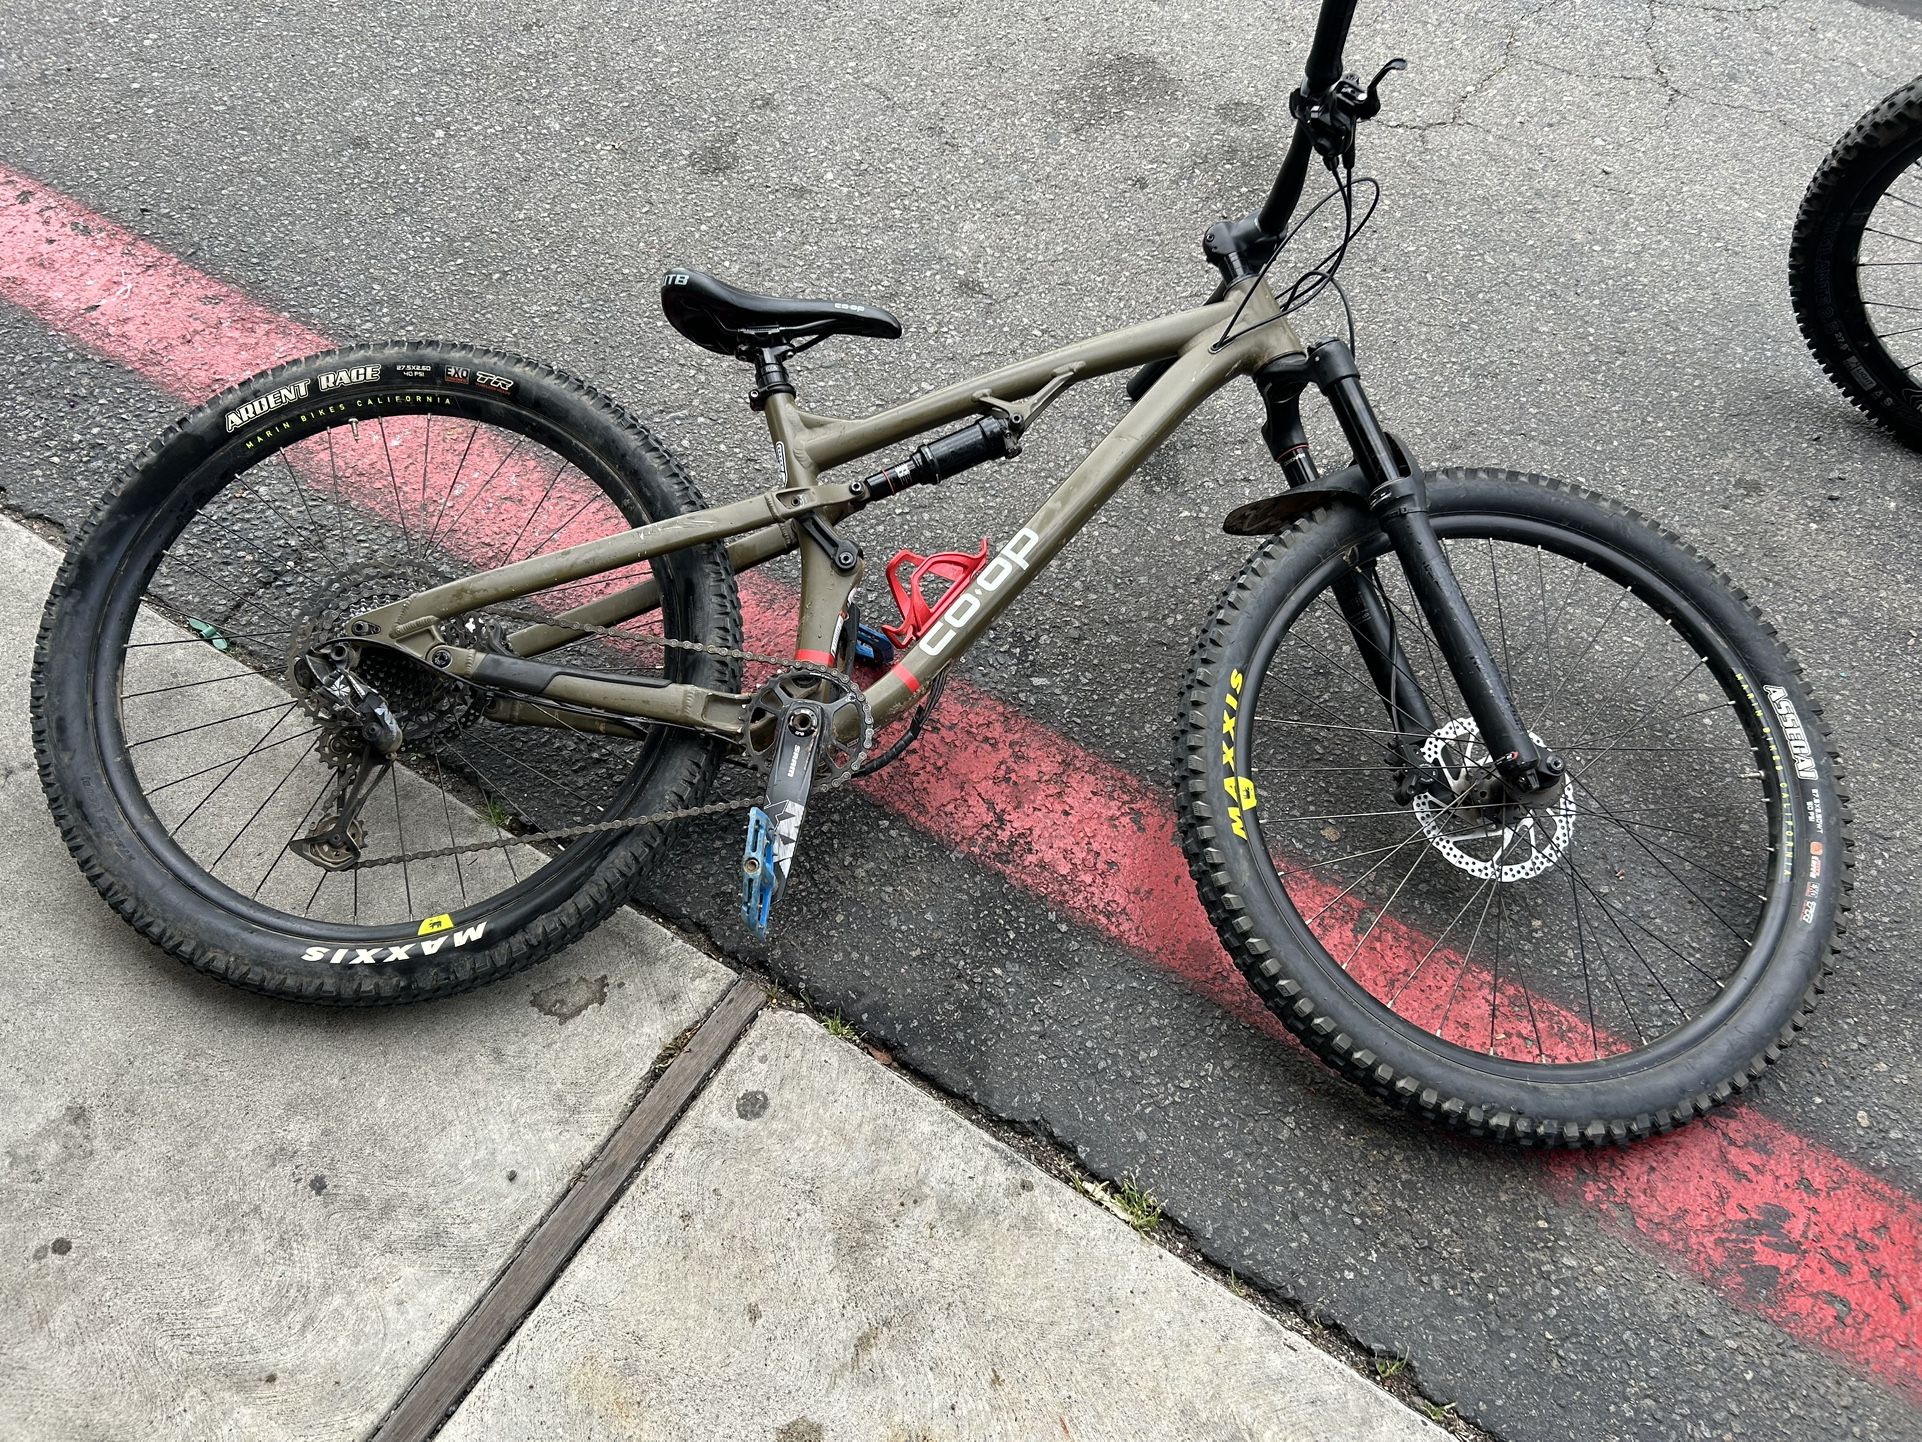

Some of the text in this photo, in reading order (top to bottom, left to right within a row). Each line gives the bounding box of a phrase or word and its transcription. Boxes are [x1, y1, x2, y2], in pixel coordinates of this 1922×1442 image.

[225, 364, 382, 433] ARDENT RACE
[446, 366, 469, 379] EXO
[476, 371, 514, 391] TR
[245, 395, 451, 450] MARIN BIKES CALIFORNIA
[1222, 668, 1248, 841] MAXXIS
[1763, 684, 1819, 781] ASSEGAI
[787, 744, 801, 778] SRAM
[1735, 672, 1794, 877] MARIN BIKES CALIFORNIA
[300, 920, 488, 965] MAXXIS
